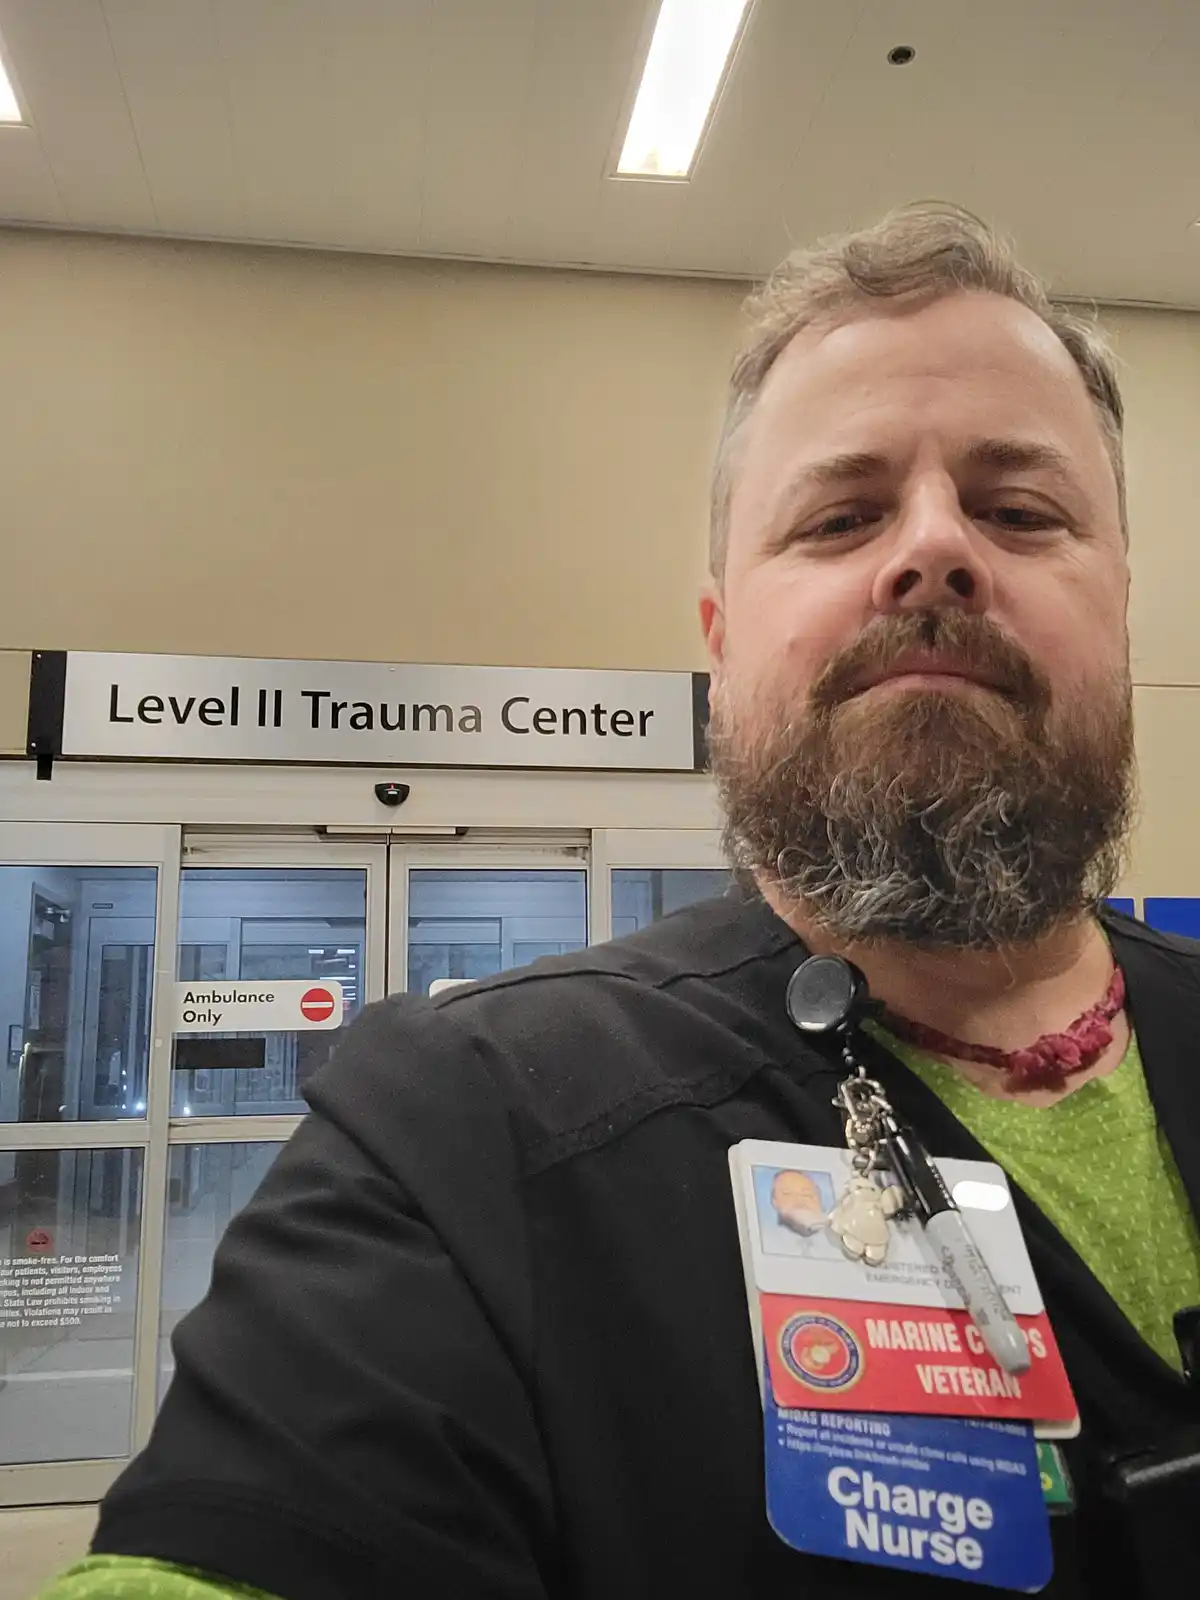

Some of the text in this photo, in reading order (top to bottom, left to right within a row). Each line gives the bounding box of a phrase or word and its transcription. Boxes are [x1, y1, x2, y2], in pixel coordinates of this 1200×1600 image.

[109, 684, 655, 737] Level II Trauma Center
[183, 990, 275, 1004] Ambulance
[183, 1009, 223, 1026] Only
[60, 1255, 73, 1264] For
[75, 1255, 87, 1263] the
[89, 1254, 119, 1263] comfort
[15, 1266, 48, 1277] patients,
[50, 1266, 81, 1275] visitors,
[82, 1265, 122, 1274] employees
[30, 1277, 44, 1285] not
[45, 1276, 82, 1286] permitted
[84, 1275, 120, 1284] anywhere
[21, 1287, 57, 1296] including
[58, 1286, 68, 1294] all
[70, 1286, 94, 1294] indoor
[95, 1285, 110, 1293] and
[3, 1294, 121, 1307] State Law prohibits smoking in
[24, 1308, 61, 1317] Violations
[63, 1308, 80, 1316] may
[81, 1306, 103, 1314] result
[6, 1320, 20, 1328] not
[21, 1319, 30, 1327] to
[31, 1318, 58, 1327] exceed
[866, 1318, 962, 1353] MARINE
[916, 1364, 1022, 1399] VETERAN
[820, 1412, 892, 1437] REPORTING
[827, 1466, 994, 1535] Charge
[845, 1508, 984, 1571] Nurse
